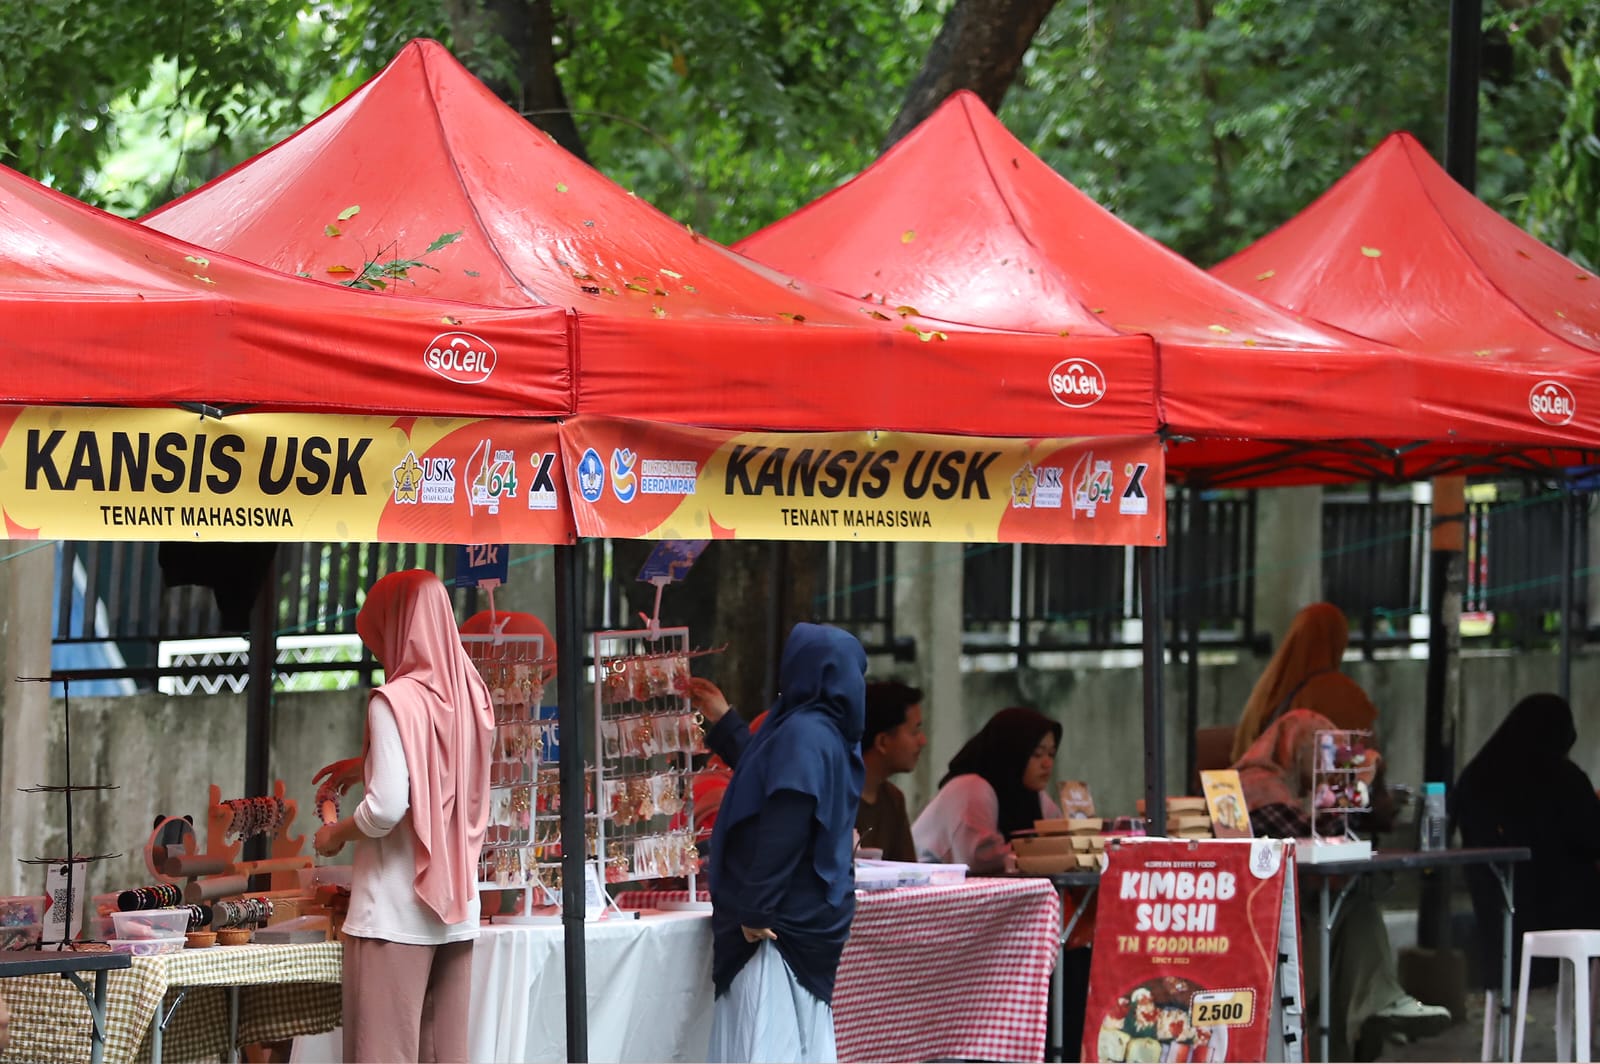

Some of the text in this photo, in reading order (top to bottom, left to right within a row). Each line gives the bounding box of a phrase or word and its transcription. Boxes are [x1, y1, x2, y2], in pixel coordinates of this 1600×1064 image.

[25, 429, 373, 496] KANSIS USK
[495, 451, 513, 461] Milad
[424, 458, 456, 482] USK
[488, 461, 517, 497] 64
[642, 461, 697, 475] DIKTISAINTEK
[725, 445, 1002, 500] KANSIS USK
[1036, 468, 1063, 488] USK
[642, 478, 695, 493] BERDAMPAK
[1088, 471, 1114, 502] 64
[100, 505, 293, 527] TENANT MAHASISWA
[782, 509, 932, 527] TENANT MAHASISWA
[1120, 871, 1236, 901] KIMBAB
[1135, 903, 1217, 932] SUSHI
[1117, 936, 1229, 954] TN FOODLAND
[1198, 1003, 1243, 1021] 2.500
